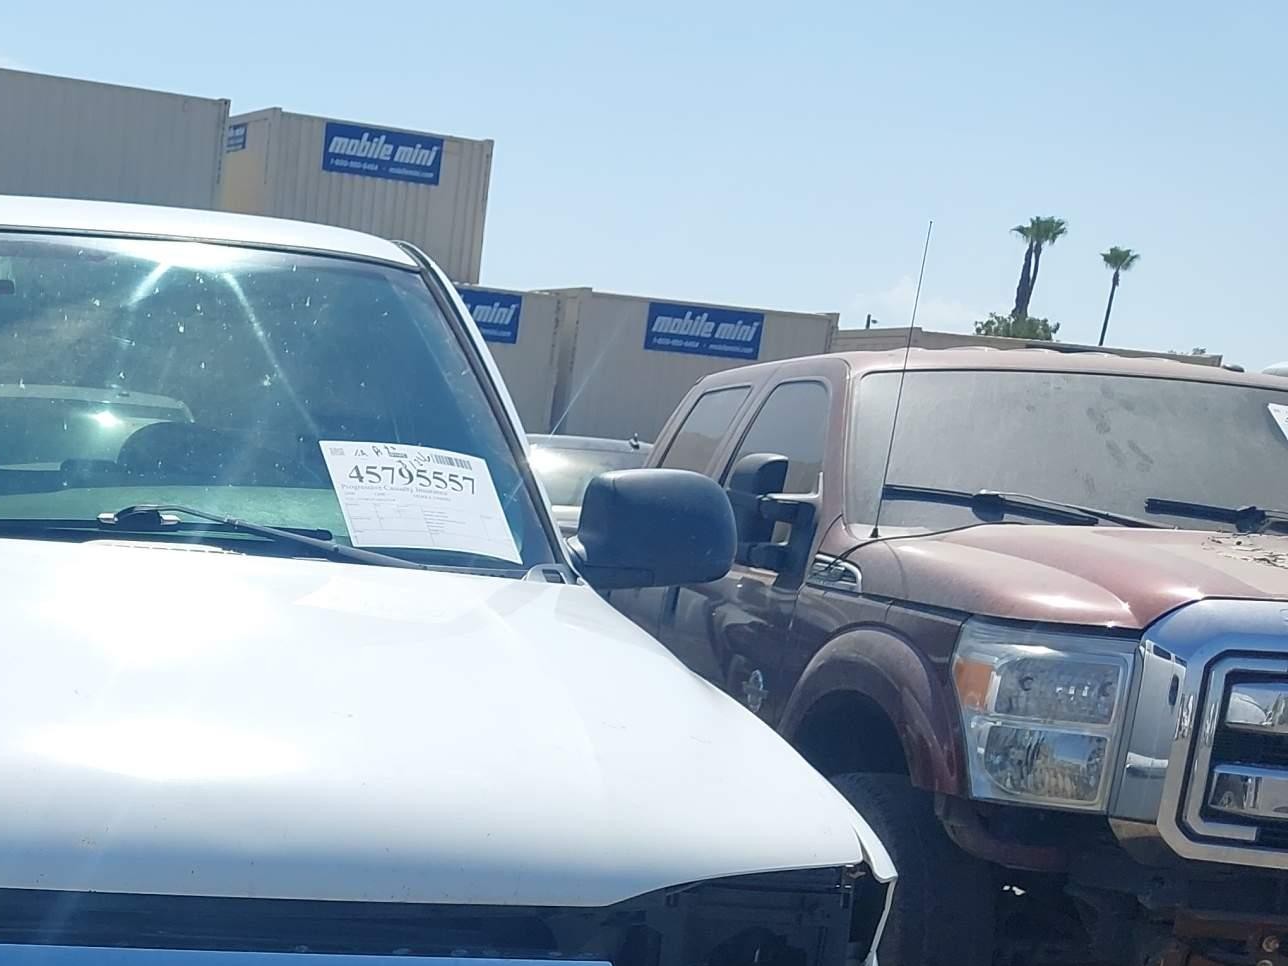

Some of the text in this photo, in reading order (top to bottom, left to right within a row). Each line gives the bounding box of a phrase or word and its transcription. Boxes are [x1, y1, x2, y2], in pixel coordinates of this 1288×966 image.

[329, 133, 393, 160] mobile
[394, 144, 439, 167] mini
[472, 302, 517, 325] mini
[652, 311, 715, 338] mobile
[714, 320, 760, 342] mini
[349, 464, 475, 495] 45795557
